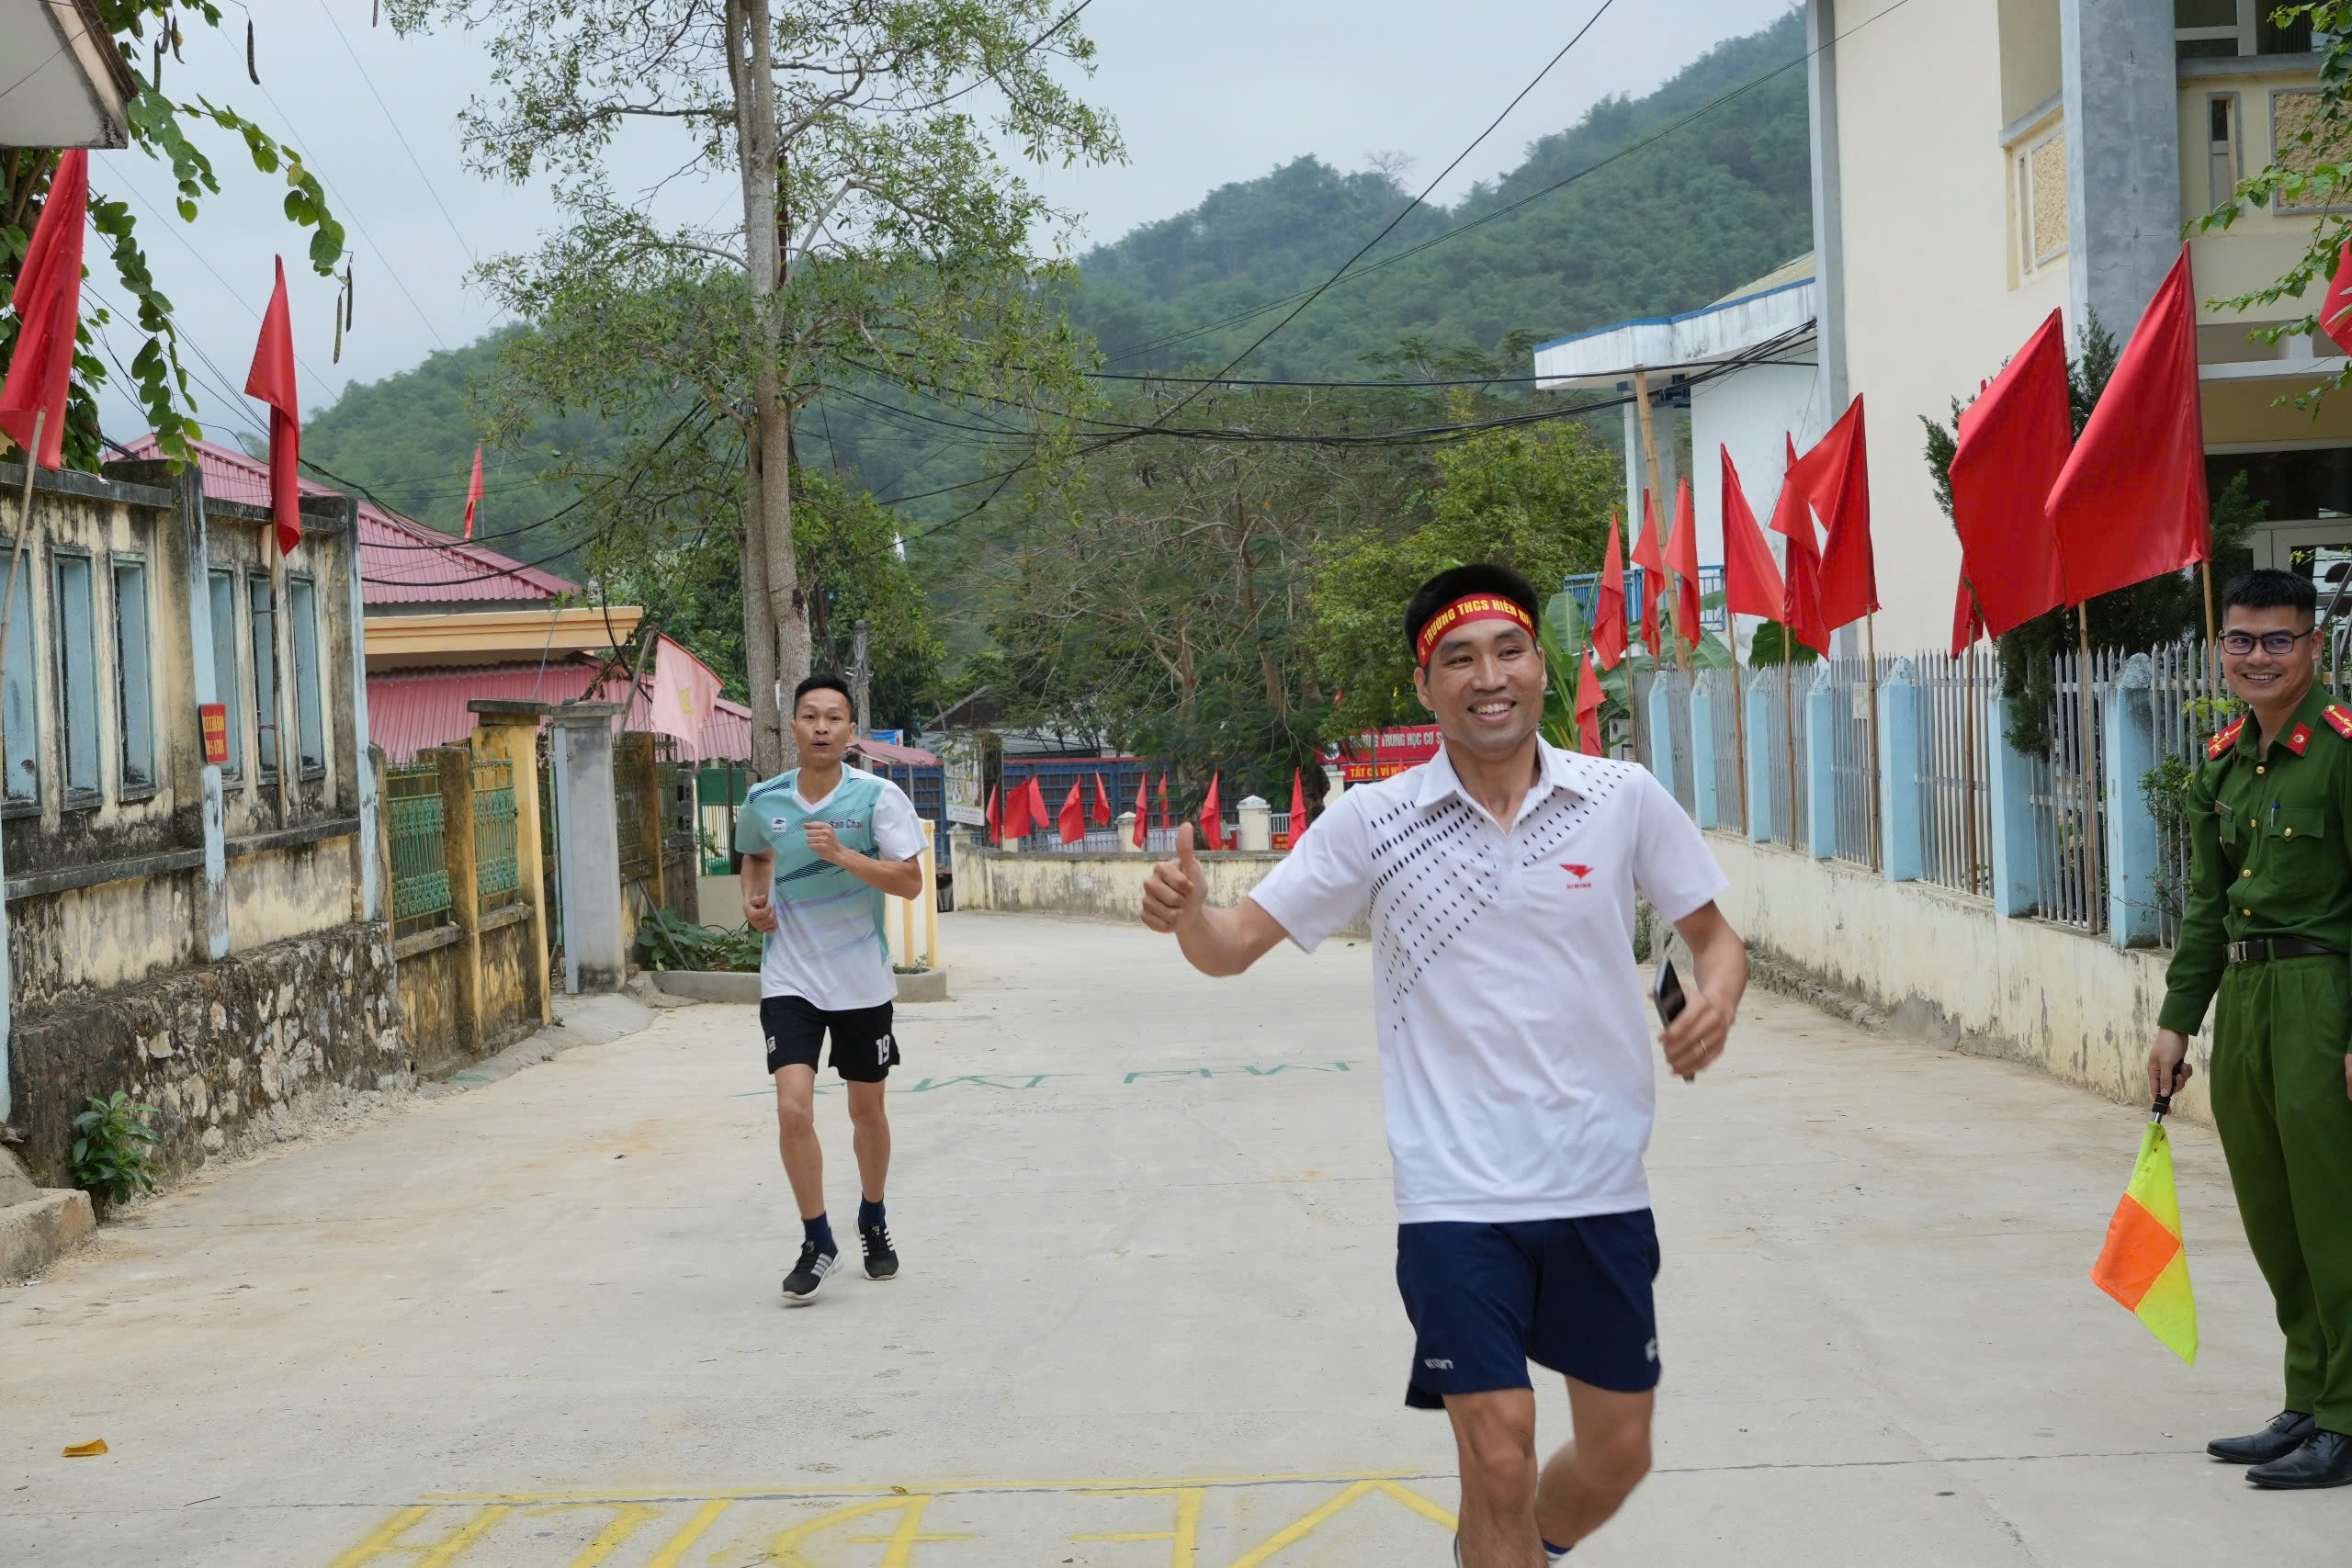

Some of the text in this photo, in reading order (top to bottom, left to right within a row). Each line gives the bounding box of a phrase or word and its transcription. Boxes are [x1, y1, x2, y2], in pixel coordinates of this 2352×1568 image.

[1457, 600, 1489, 615] THCS
[1382, 733, 1405, 747] TRUNG
[1407, 732, 1421, 749] HỌC
[1424, 731, 1434, 745] CƠ
[876, 1034, 890, 1066] 19
